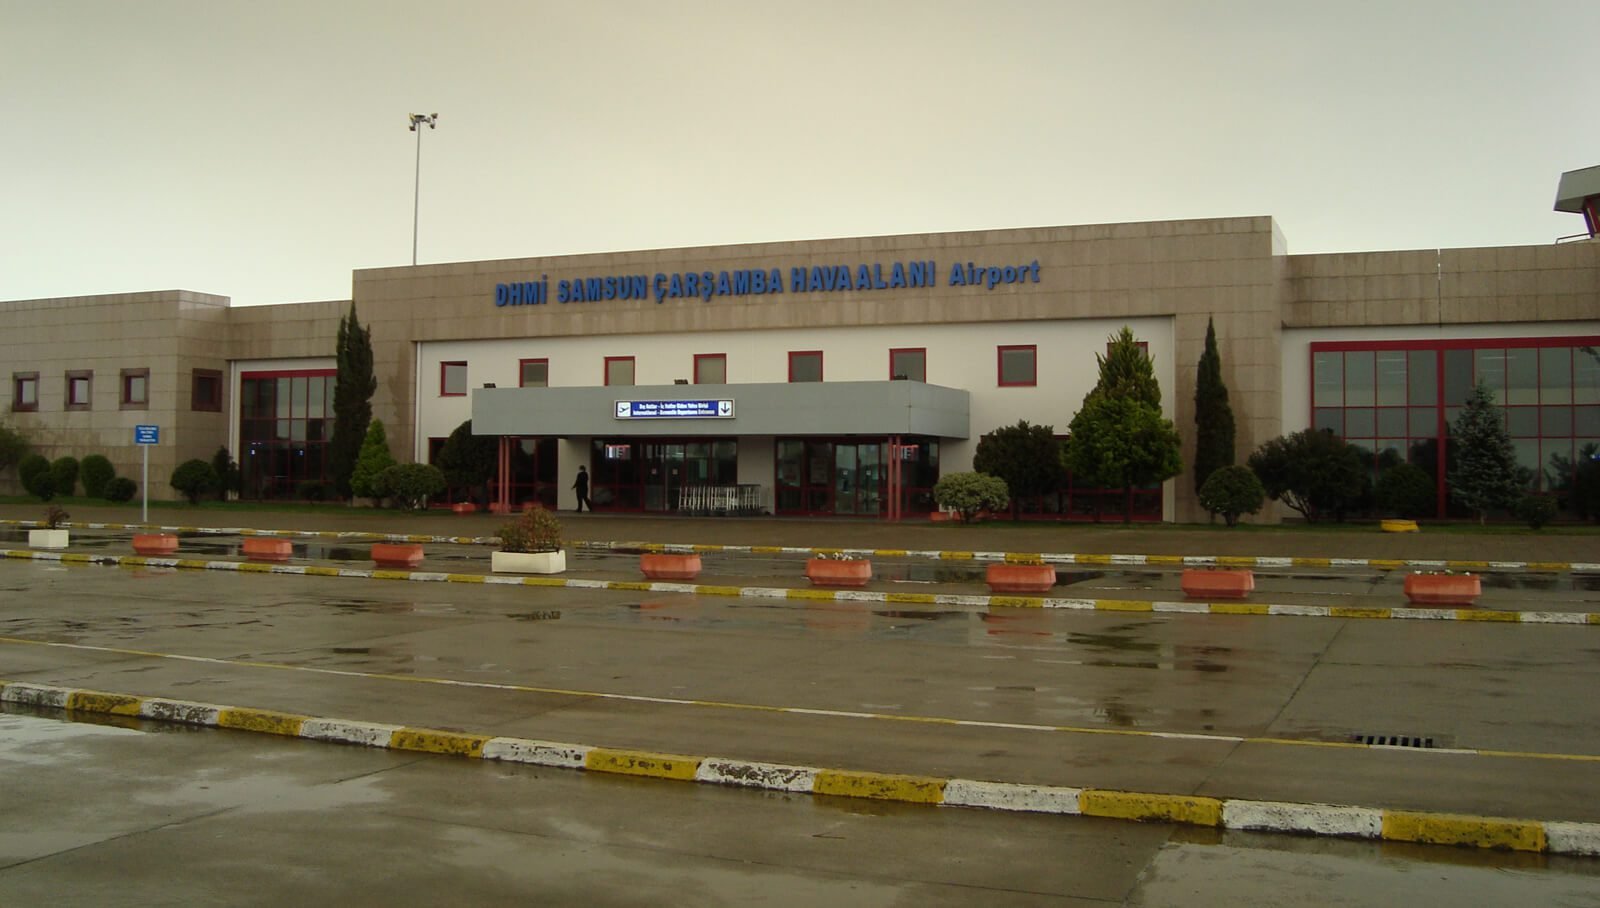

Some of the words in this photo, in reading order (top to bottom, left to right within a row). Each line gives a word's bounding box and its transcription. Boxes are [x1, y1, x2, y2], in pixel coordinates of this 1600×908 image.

[557, 274, 647, 303] SAMSUN
[652, 268, 783, 304] ÇARŞAMBA
[949, 259, 1041, 290] Airport
